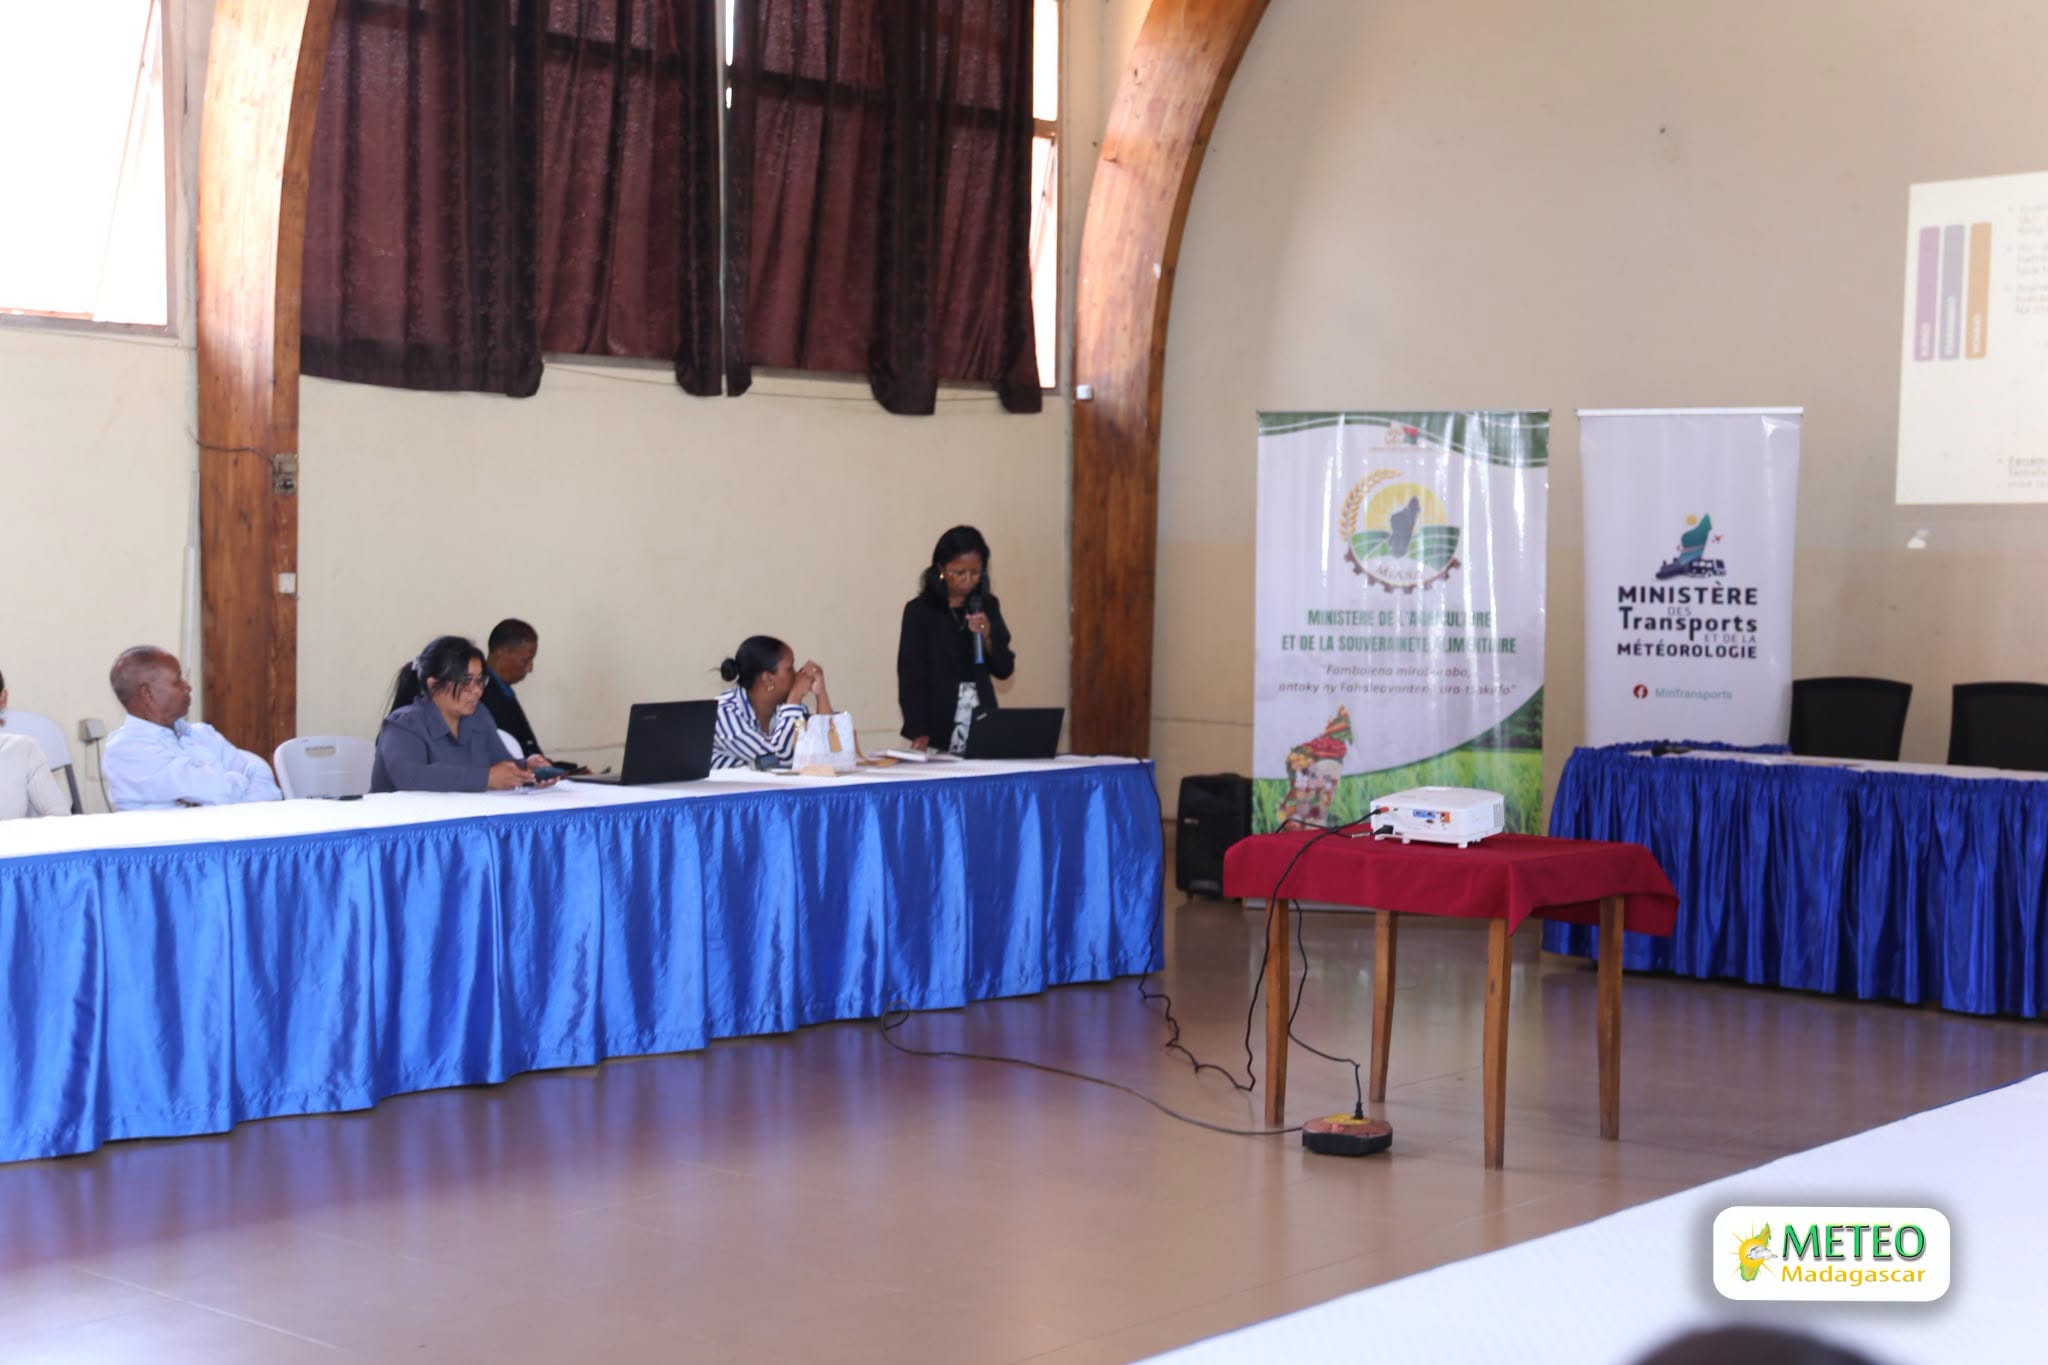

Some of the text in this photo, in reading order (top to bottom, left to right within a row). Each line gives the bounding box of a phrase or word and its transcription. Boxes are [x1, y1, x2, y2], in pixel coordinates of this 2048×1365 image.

[1618, 581, 1758, 605] MINISTÈRE
[1379, 610, 1394, 626] DE
[1668, 606, 1692, 617] DES
[1618, 606, 1758, 641] Transports
[1281, 635, 1296, 651] ET
[1300, 635, 1316, 651] DE
[1319, 635, 1335, 651] LA
[1704, 634, 1757, 643] ET DE LA
[1617, 639, 1758, 659] MÉTÉOROLOGIE
